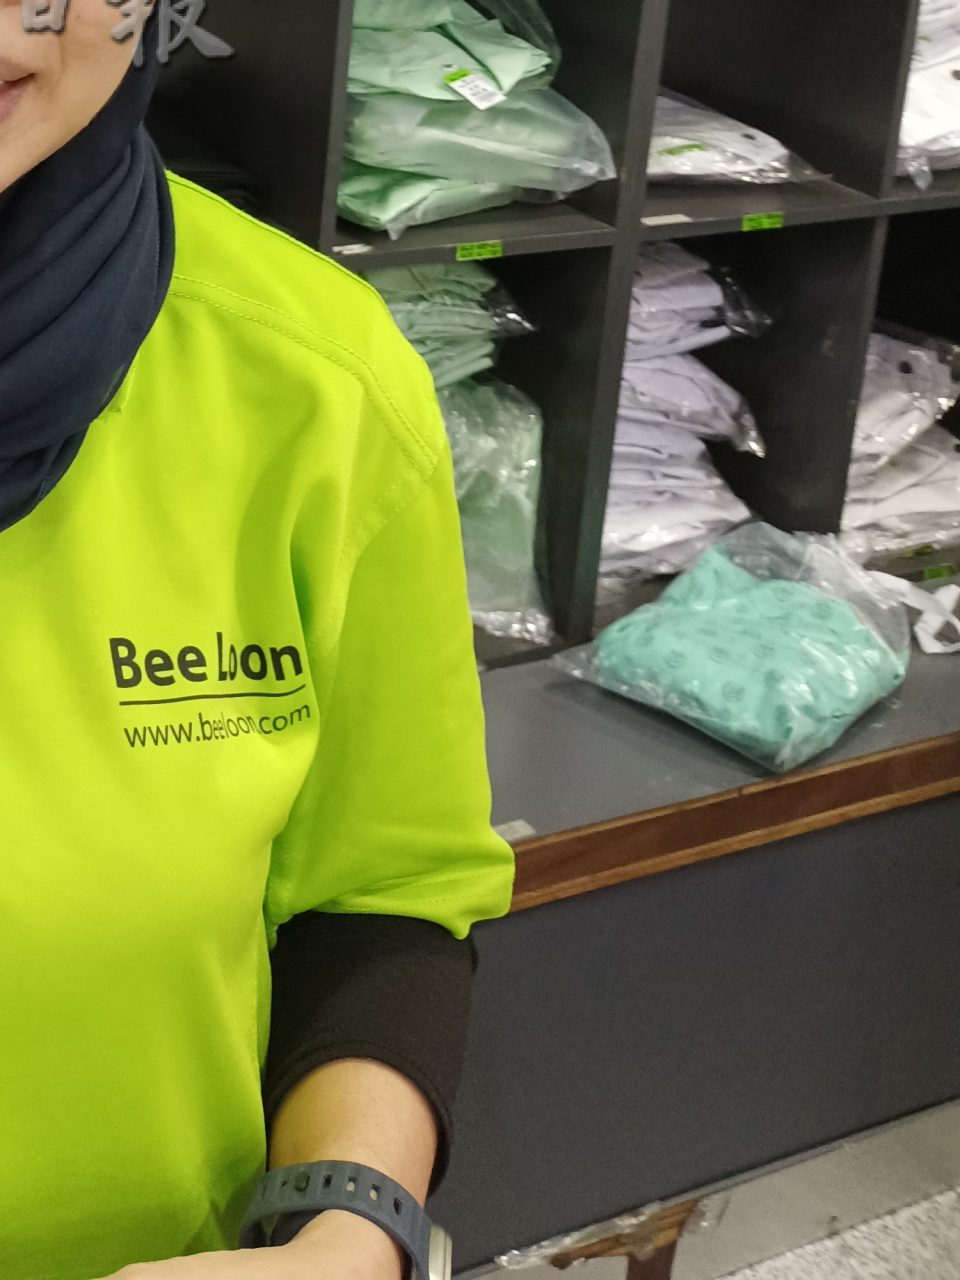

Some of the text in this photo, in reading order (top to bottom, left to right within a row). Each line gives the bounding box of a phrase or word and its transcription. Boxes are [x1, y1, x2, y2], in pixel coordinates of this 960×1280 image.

[109, 632, 303, 688] Bee Loon
[124, 704, 311, 748] www.beeloon.com
